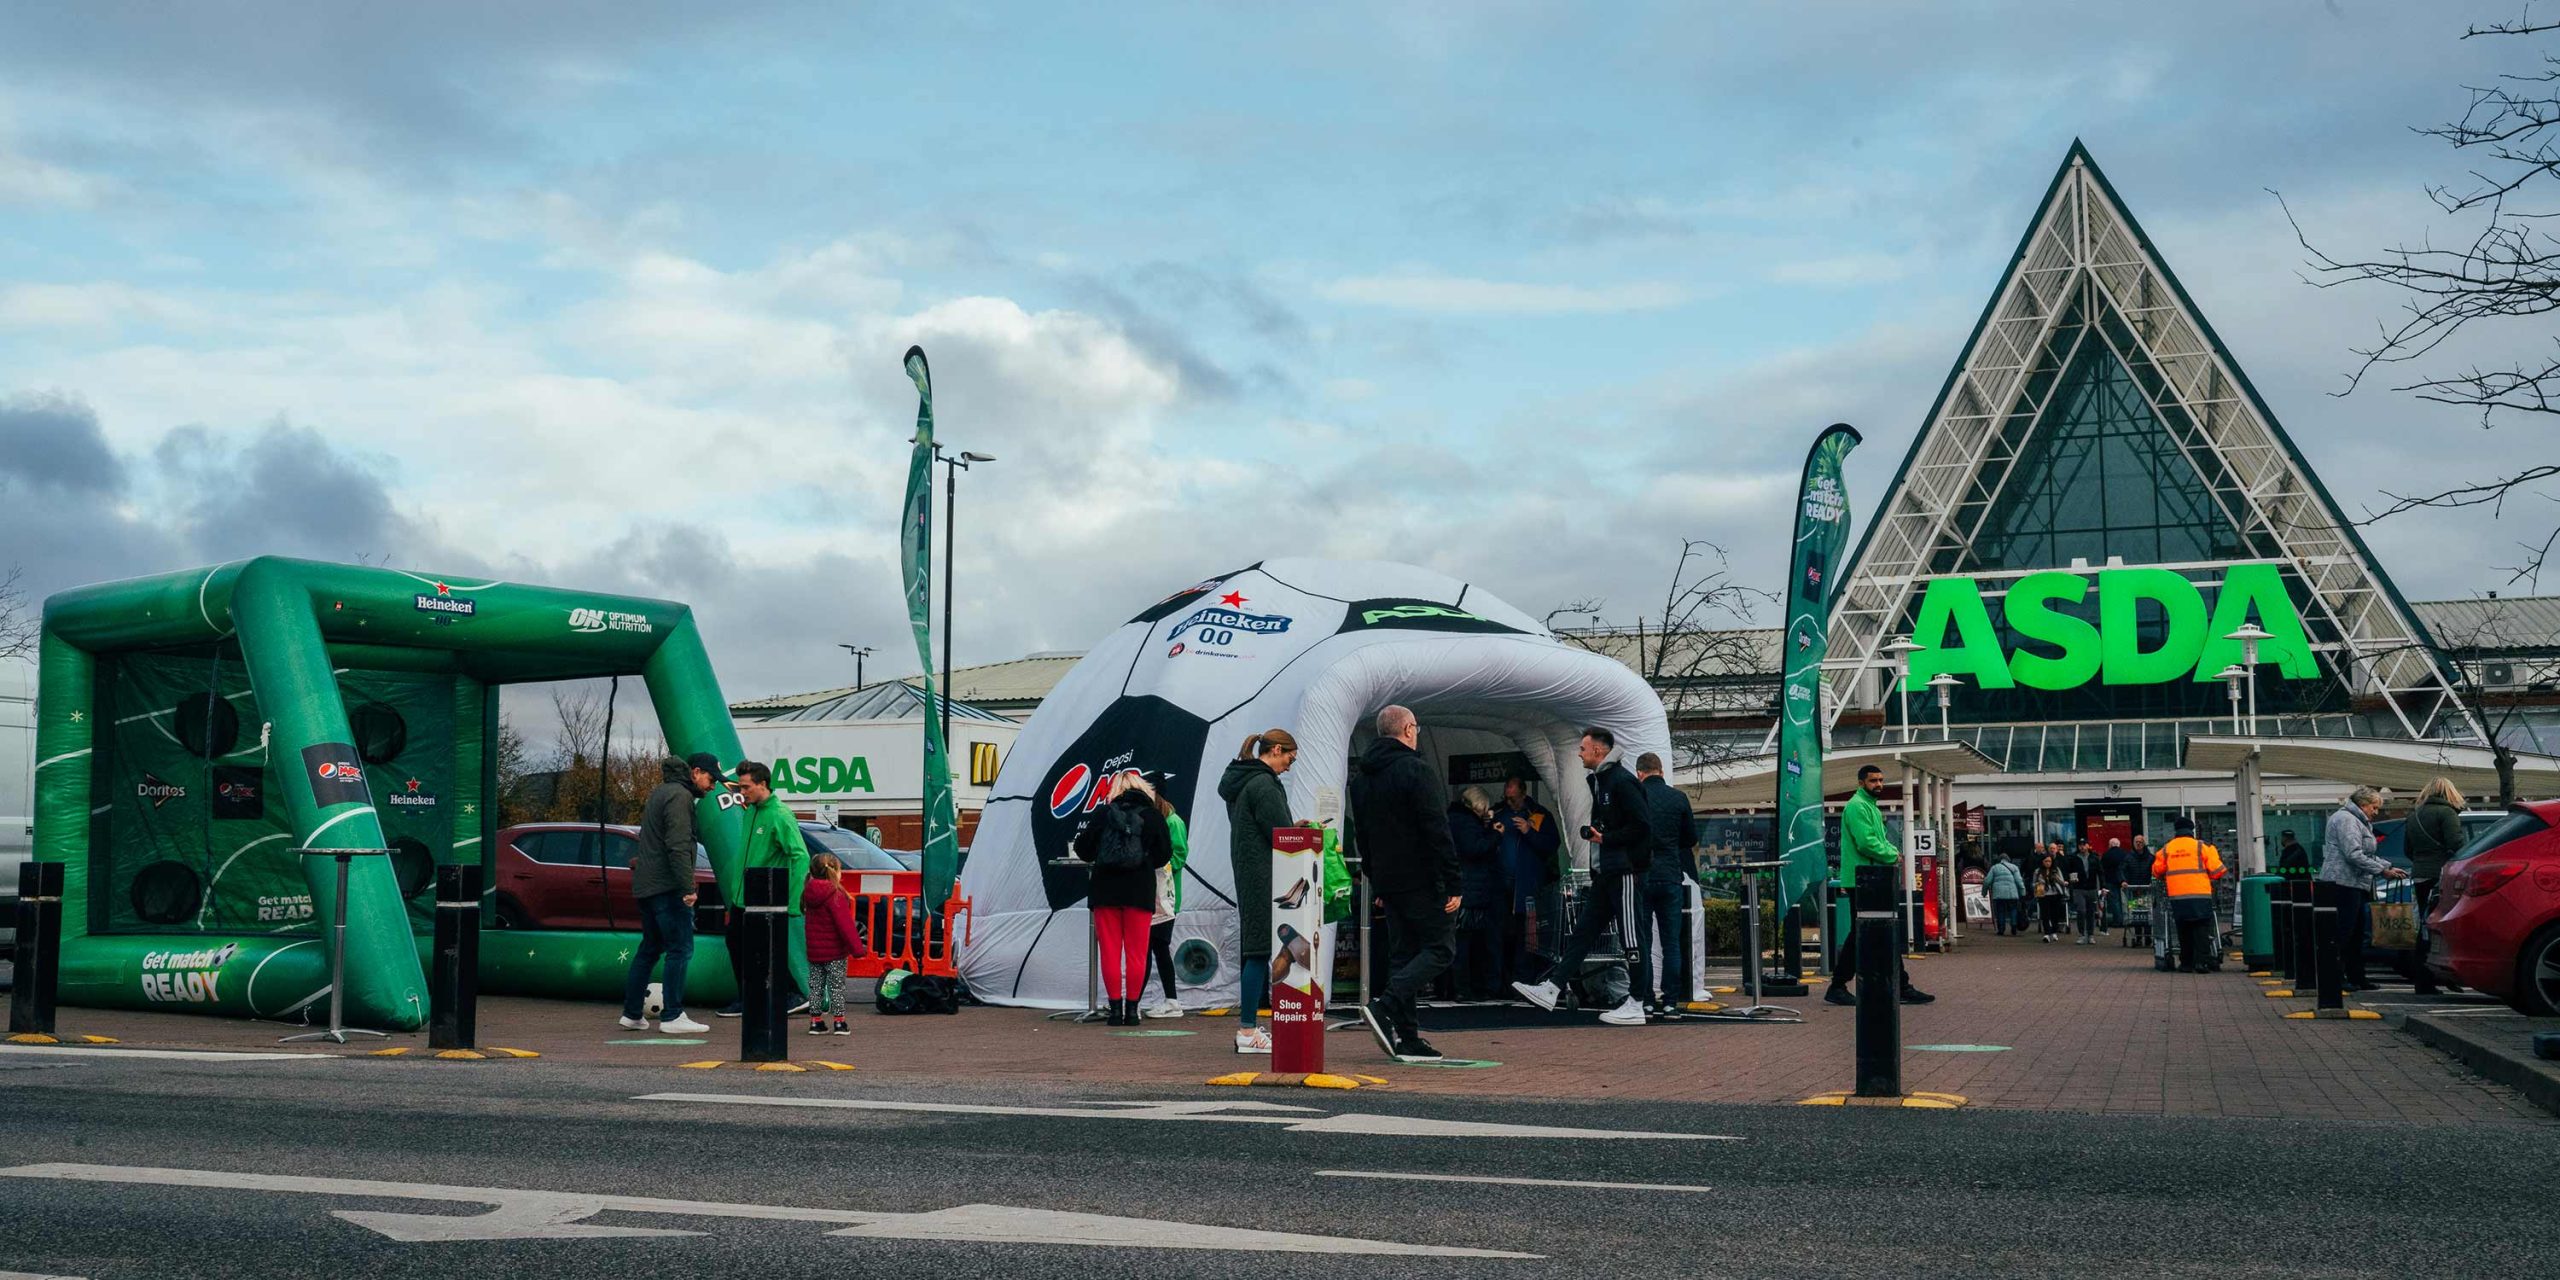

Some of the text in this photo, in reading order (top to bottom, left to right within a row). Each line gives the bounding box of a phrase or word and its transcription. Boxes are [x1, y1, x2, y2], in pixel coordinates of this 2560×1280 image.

[1817, 477, 1837, 490] Get
[1805, 502, 1846, 524] READY
[417, 596, 473, 614] Heineken
[609, 611, 646, 624] OPTIMUM
[1175, 610, 1282, 636] Heineken
[609, 620, 652, 633] NUTRITION
[1895, 563, 2321, 692] ASDA
[1199, 627, 1233, 646] 0.0
[1102, 749, 1134, 772] pepsi
[771, 756, 875, 794] ASDA
[138, 783, 186, 797] Doritos
[390, 794, 436, 806] Heineken
[1725, 829, 1741, 838] Dry
[1914, 835, 1932, 850] 15
[258, 895, 279, 906] Get
[2379, 917, 2412, 930] M&S
[142, 949, 215, 970] Get match
[141, 971, 220, 1003] READY
[1279, 999, 1302, 1010] Shoe
[1273, 1011, 1307, 1024] Repairs
